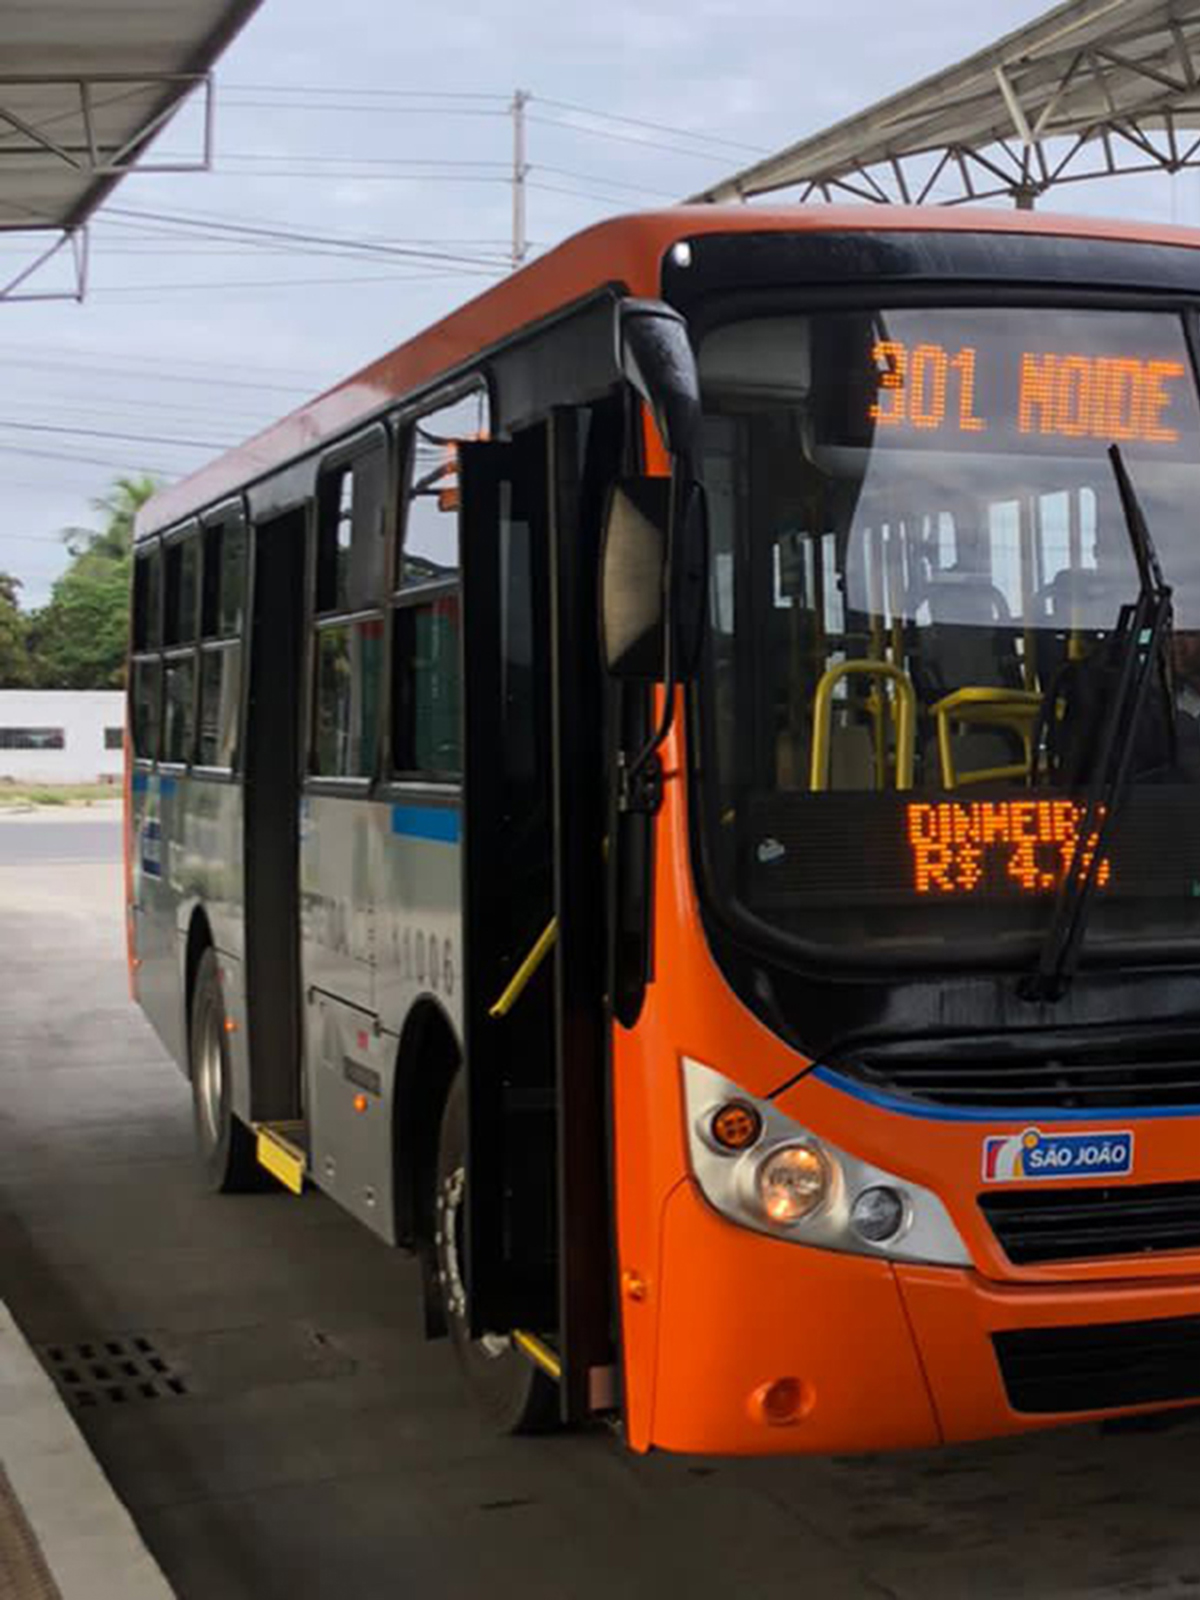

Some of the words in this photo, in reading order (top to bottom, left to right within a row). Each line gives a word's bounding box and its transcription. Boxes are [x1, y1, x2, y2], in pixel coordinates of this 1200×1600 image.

[868, 340, 987, 430] 301
[915, 842, 982, 892] R$
[1029, 1144, 1072, 1168] SÃO
[1074, 1141, 1126, 1165] JOÃO
